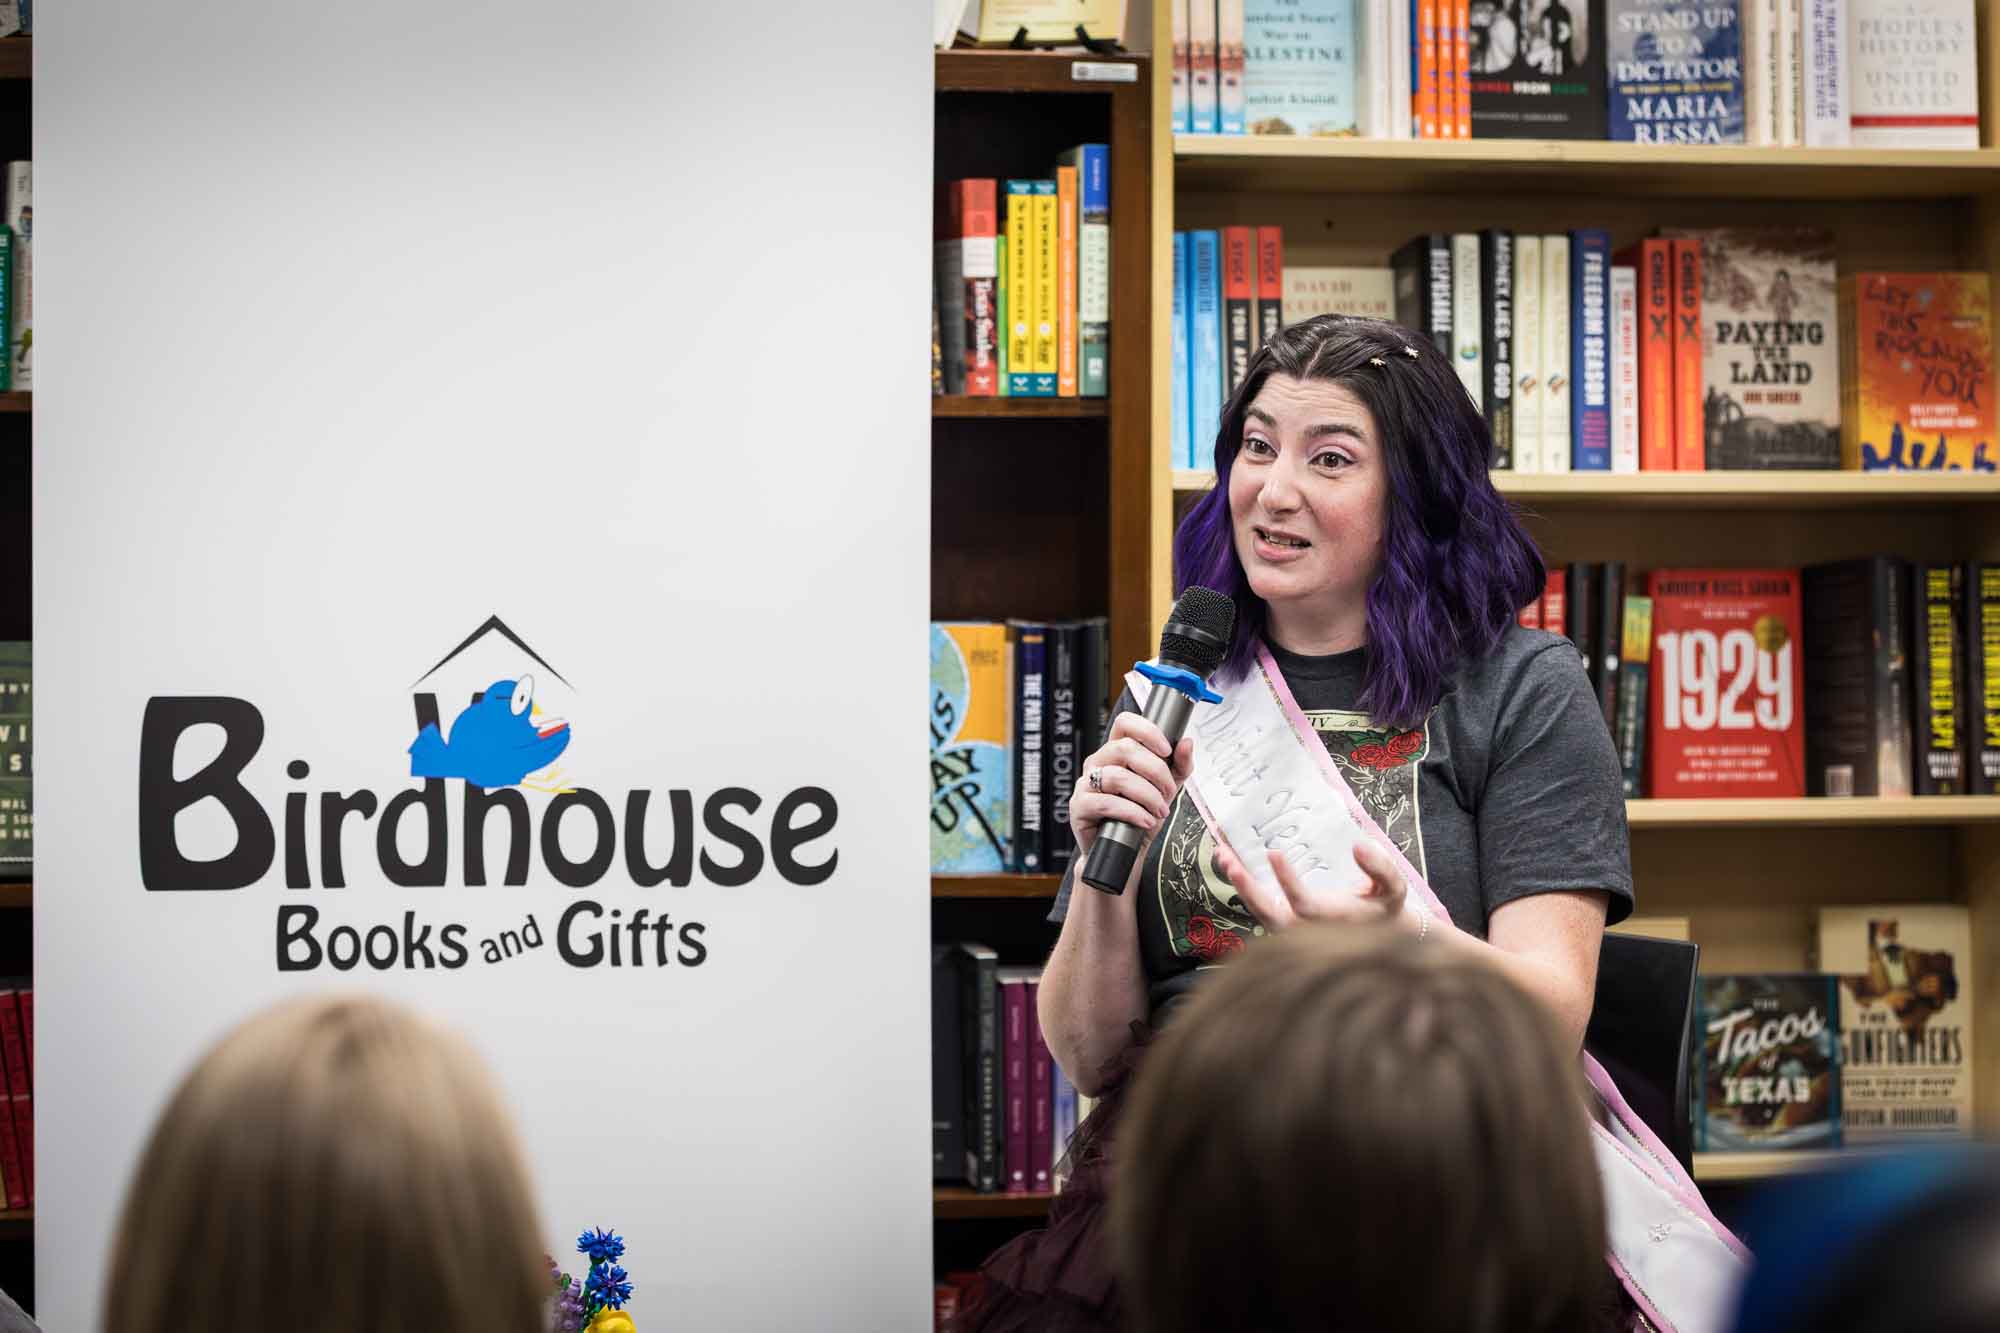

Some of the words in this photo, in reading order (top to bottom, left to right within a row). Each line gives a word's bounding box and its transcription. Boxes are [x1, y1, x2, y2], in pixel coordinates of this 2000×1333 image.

[1617, 10, 1701, 32] STAND
[1703, 7, 1737, 29] UP
[1243, 47, 1344, 61] ALESTINE
[1656, 36, 1684, 55] TO
[1687, 35, 1705, 55] A
[1857, 38, 1963, 54] HISTORY
[1616, 57, 1741, 82] DICTATOR
[1626, 95, 1729, 121] MARIA
[1632, 121, 1722, 144] RESSA
[1582, 251, 1605, 335] FREEDOM
[1231, 306, 1247, 342] TONI
[1263, 306, 1278, 336] TON
[1715, 320, 1824, 345] PAYING
[1582, 336, 1605, 406] SEASON
[1729, 361, 1812, 384] LAND
[1927, 569, 1951, 599] THE
[1023, 673, 1042, 698] THE
[1656, 628, 1794, 732] 1929
[1023, 699, 1042, 732] PATH
[1053, 688, 1073, 736] STAR
[1307, 716, 1331, 728] IV
[1023, 734, 1042, 750] TO
[1930, 714, 1955, 749] SPY
[139, 692, 839, 891] Birdhouse
[1053, 741, 1073, 824] BOUND
[277, 903, 469, 971] Books
[480, 914, 544, 964] and
[556, 899, 709, 969] Gifts
[1706, 1007, 1825, 1065] Tacos
[1721, 1075, 1811, 1104] TEXAS
